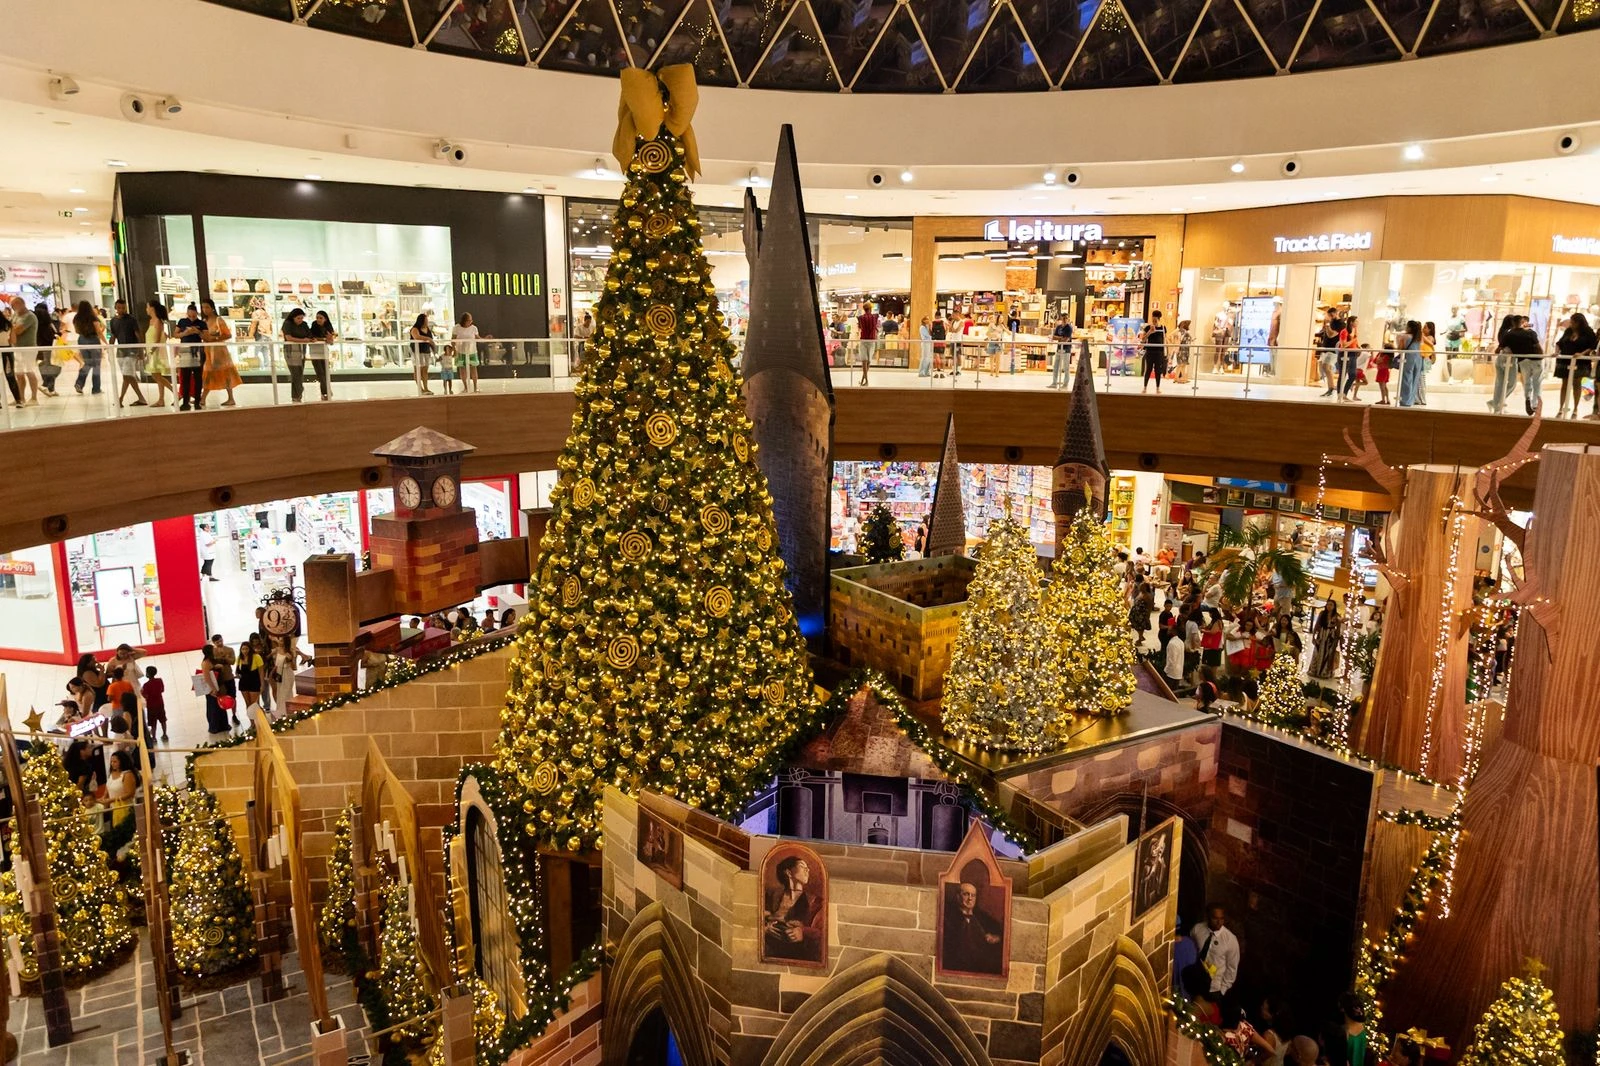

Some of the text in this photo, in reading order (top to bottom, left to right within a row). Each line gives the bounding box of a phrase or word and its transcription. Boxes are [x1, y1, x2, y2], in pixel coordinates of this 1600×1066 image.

[1008, 219, 1103, 241] leitura
[461, 271, 541, 296] SANTA LOLLA
